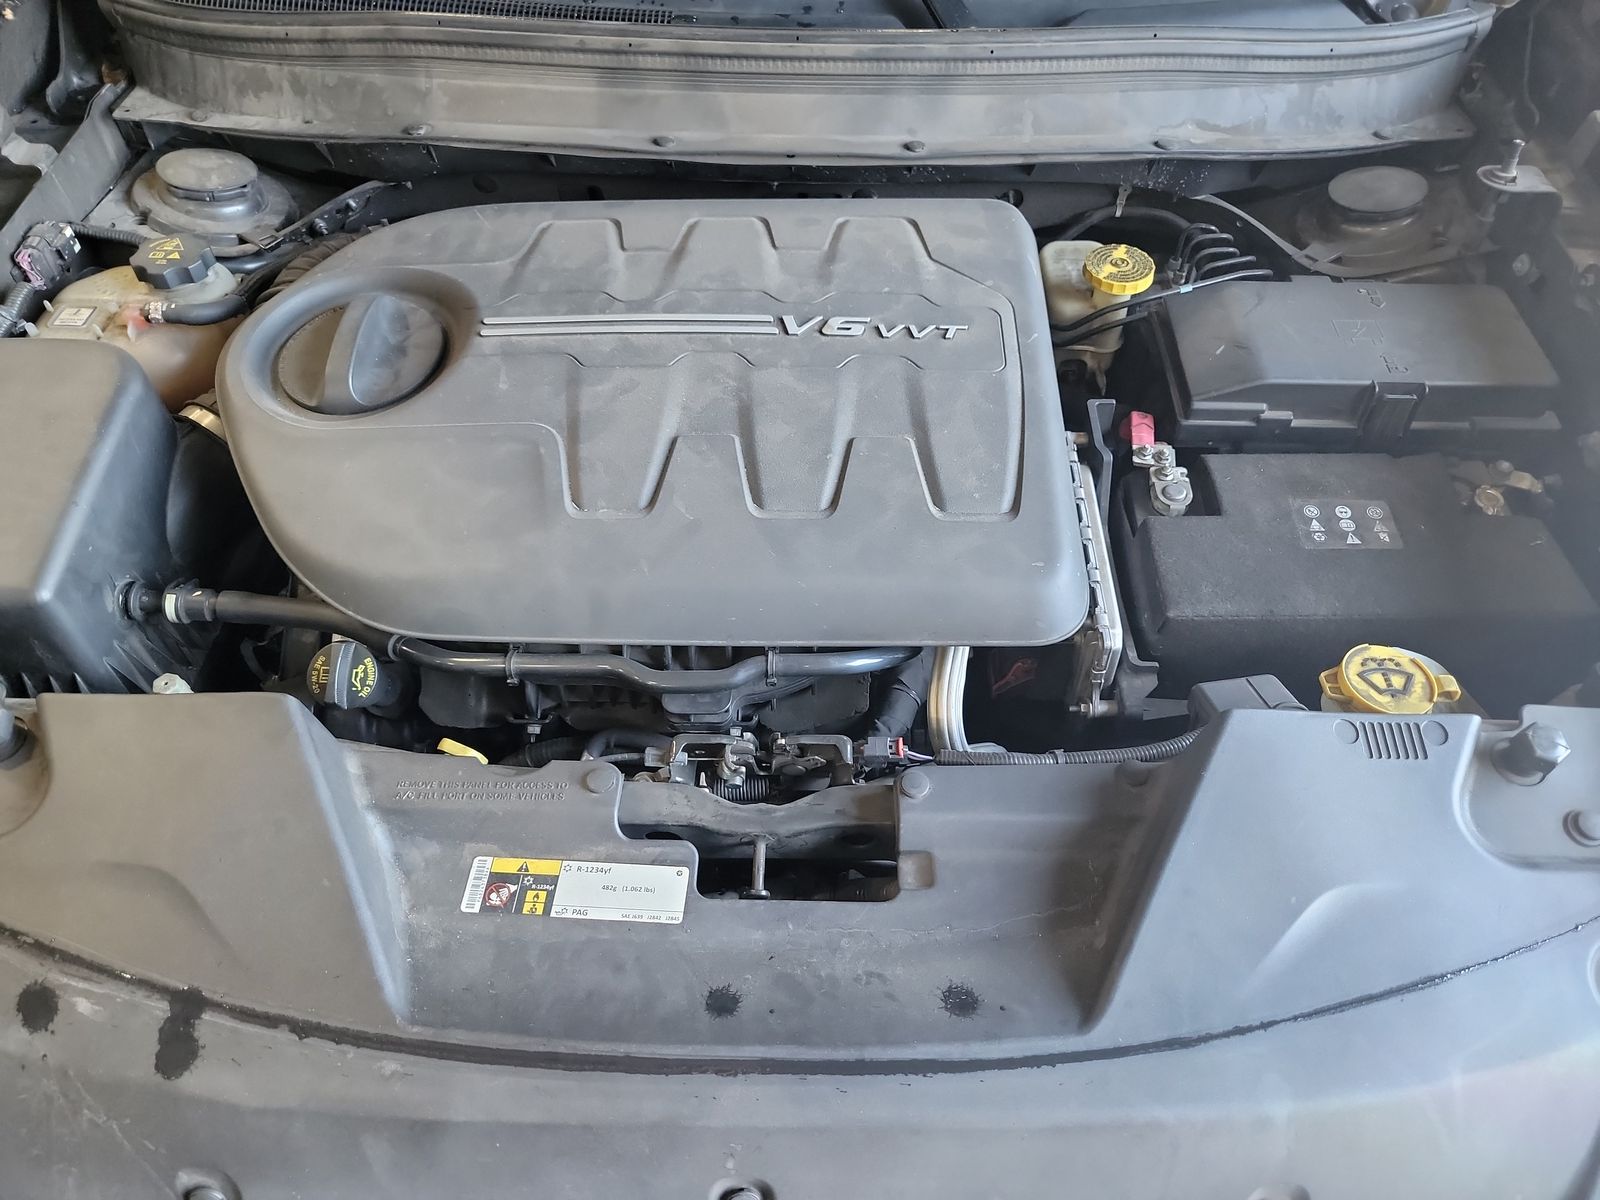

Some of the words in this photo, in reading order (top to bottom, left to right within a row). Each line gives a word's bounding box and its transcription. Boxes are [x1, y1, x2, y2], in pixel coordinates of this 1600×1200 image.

[779, 314, 870, 338] V6
[875, 323, 969, 340] VVT
[314, 655, 326, 669] SAE
[364, 657, 375, 685] ENGINE
[312, 671, 320, 694] 5W-20
[358, 687, 371, 698] OIL
[396, 780, 437, 789] REMOVE
[439, 781, 460, 789] THIS
[462, 781, 492, 789] PANEL
[495, 781, 515, 789] FOR
[516, 781, 555, 790] ACCESS
[556, 782, 569, 790] TO
[394, 791, 416, 801] A/C
[417, 792, 438, 801] FILL
[441, 792, 467, 801] PORT
[469, 792, 486, 801] ON
[487, 792, 516, 801] SOME
[518, 792, 566, 801] VEHICLES
[576, 865, 612, 876] R-1234yf
[531, 883, 555, 891] R-1234yf
[601, 884, 617, 893] 482g
[643, 885, 656, 894] lbs)
[571, 908, 588, 917] PAG
